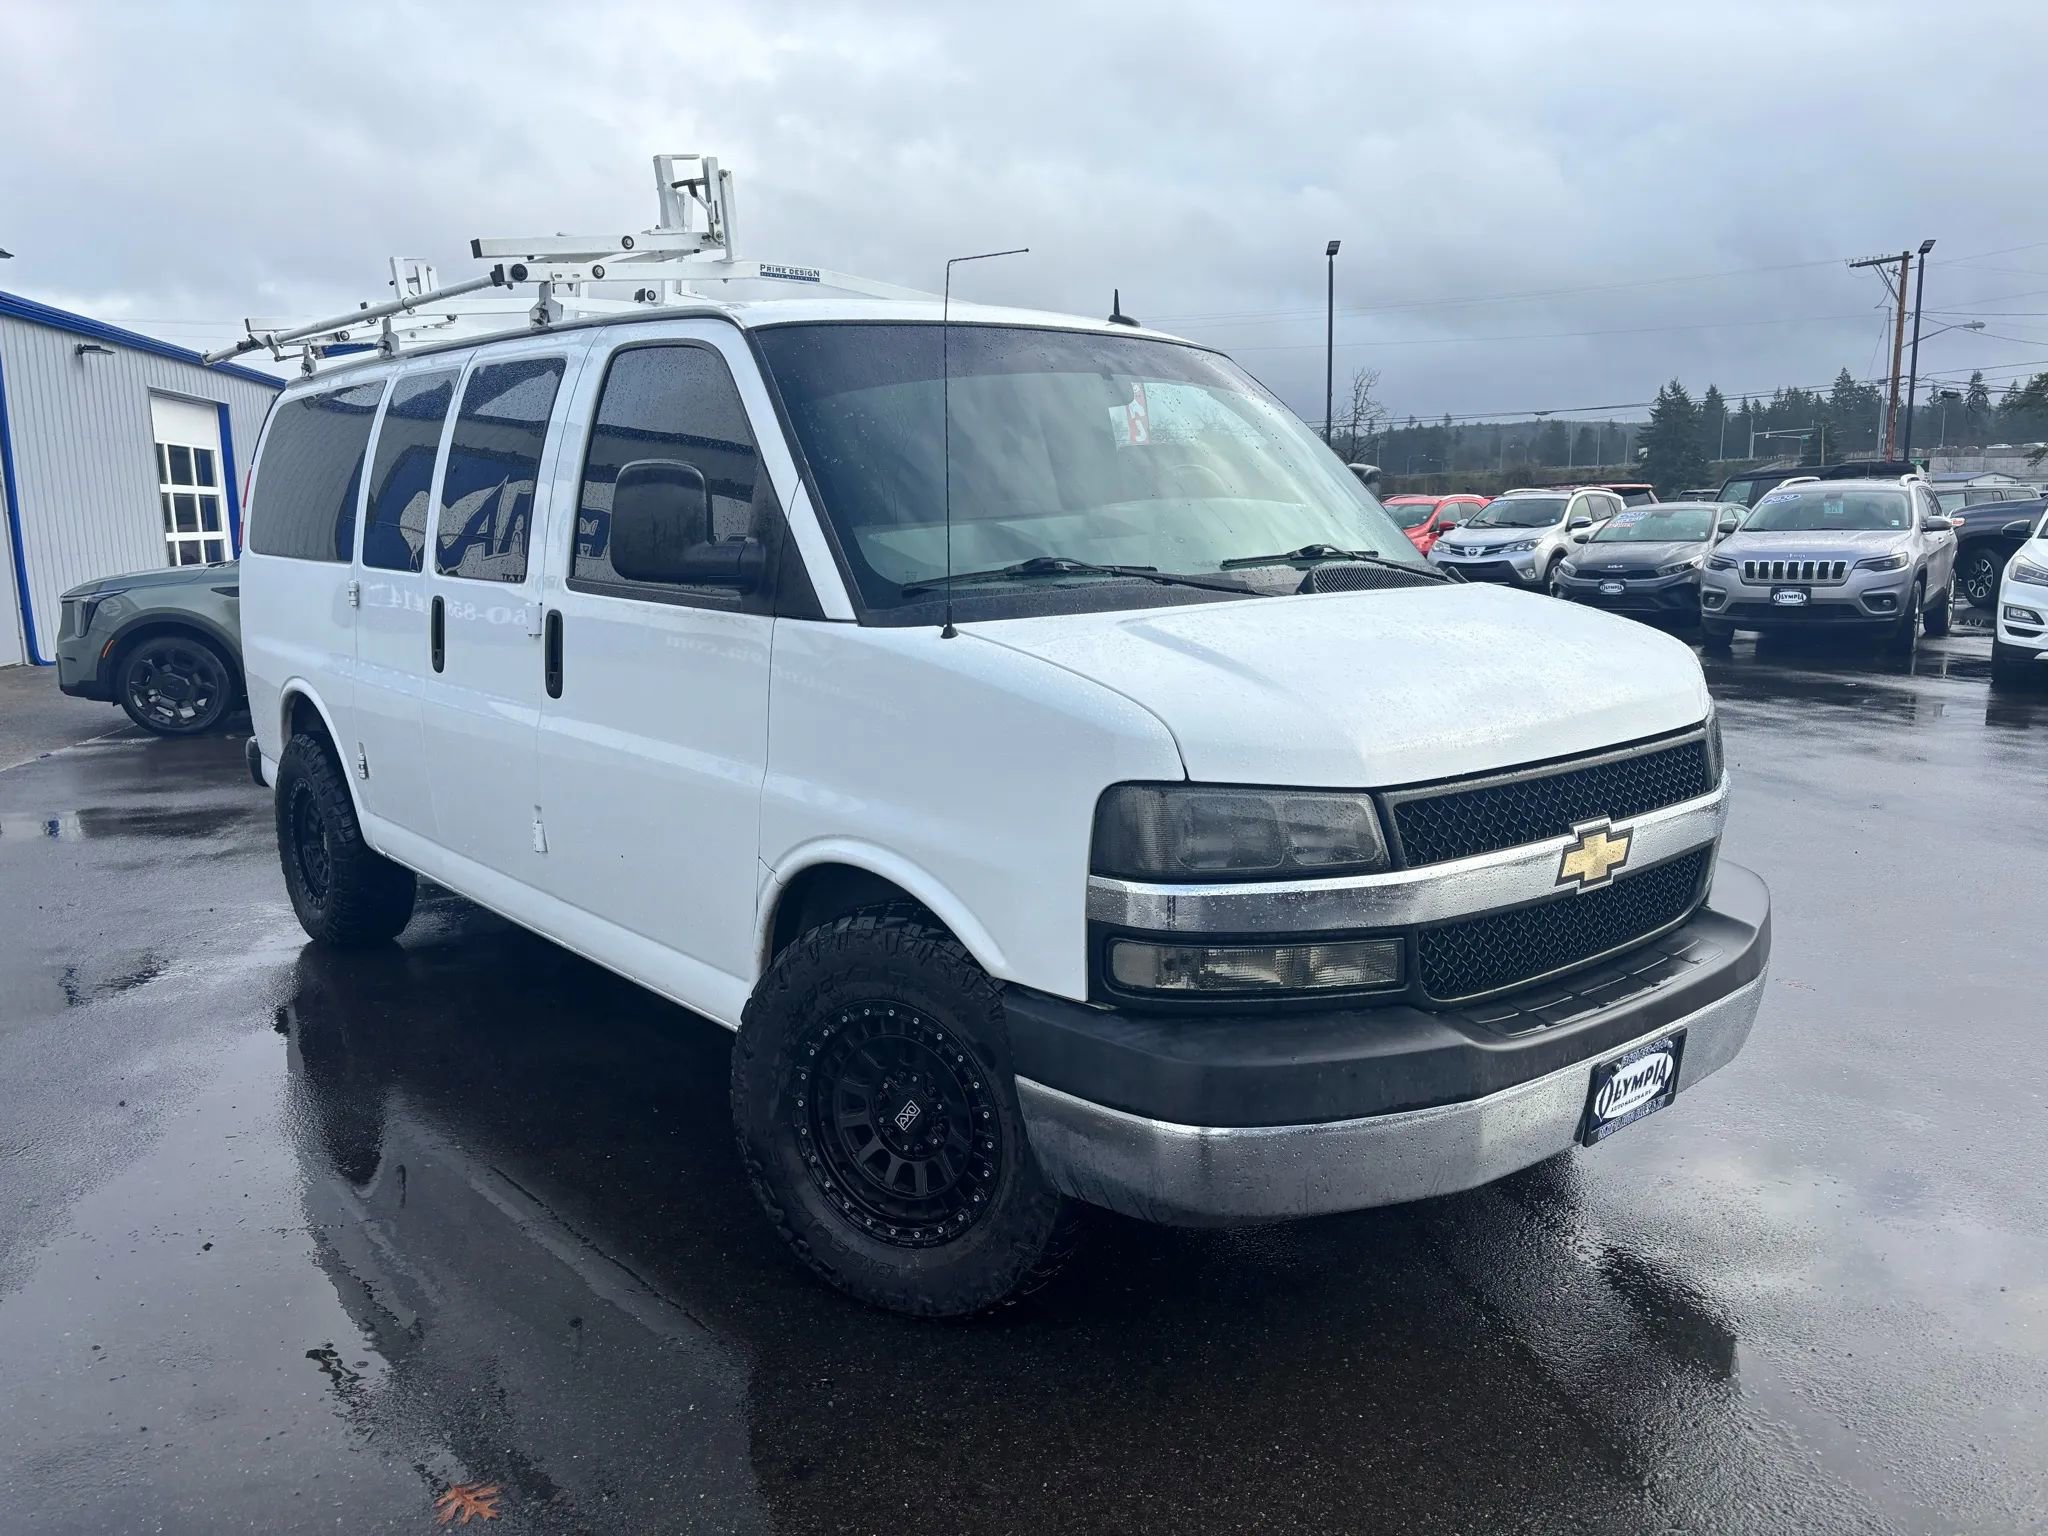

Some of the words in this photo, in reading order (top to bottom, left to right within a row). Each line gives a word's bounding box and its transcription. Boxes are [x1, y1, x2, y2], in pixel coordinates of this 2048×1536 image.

[760, 264, 787, 274] PRIME
[789, 268, 820, 277] DESIGN
[1775, 591, 1805, 602] OLYMPIA
[1598, 1051, 1669, 1122] OLYMPIA
